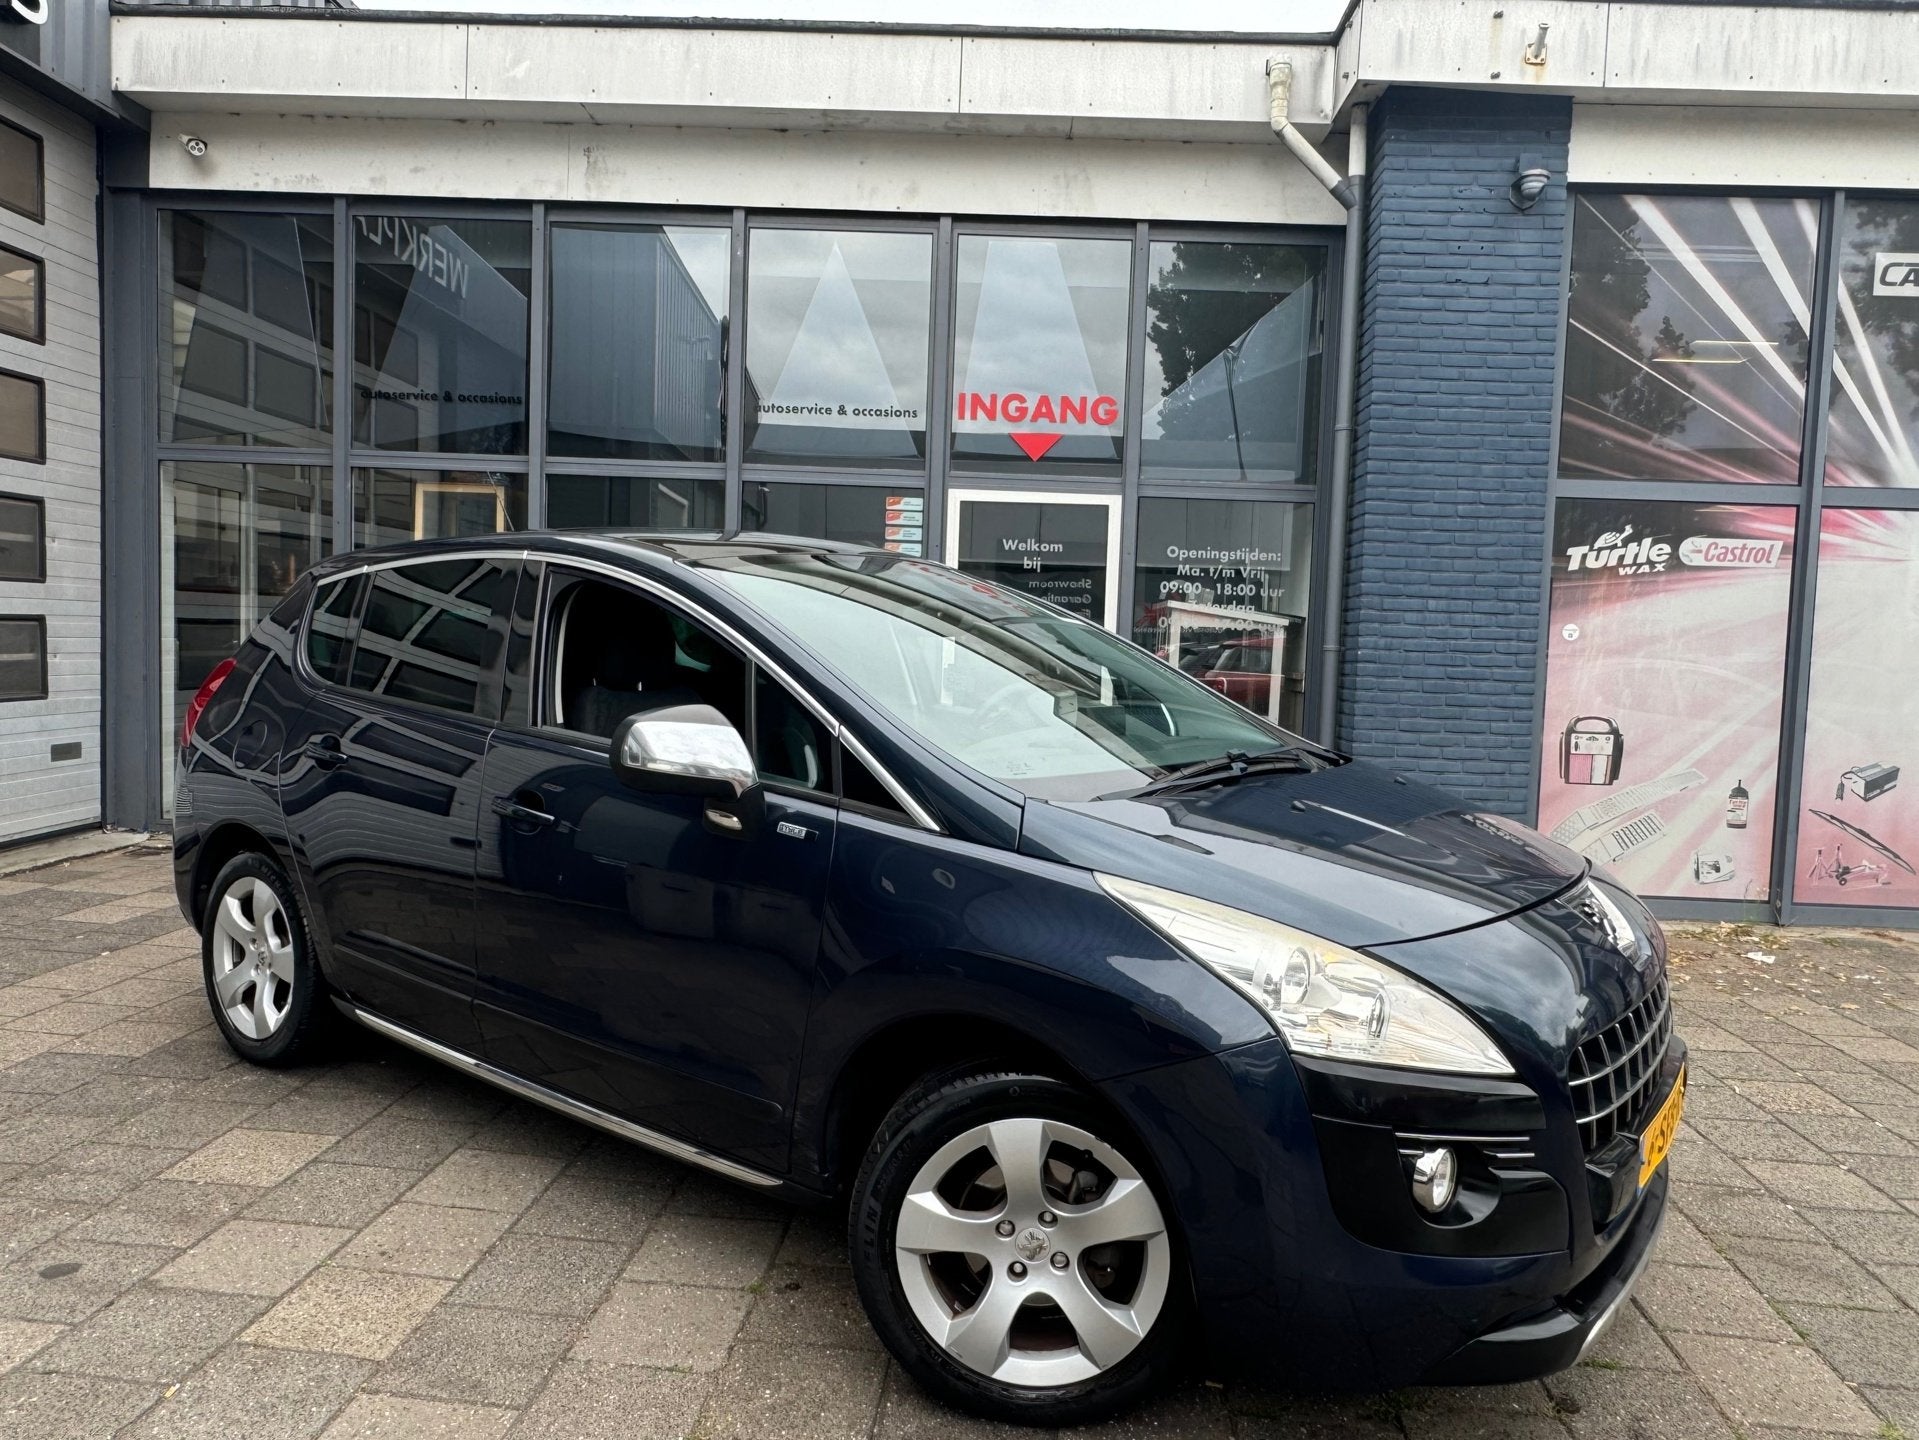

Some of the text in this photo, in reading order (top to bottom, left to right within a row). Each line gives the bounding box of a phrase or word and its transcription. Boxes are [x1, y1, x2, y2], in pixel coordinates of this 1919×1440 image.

[360, 389, 523, 405] autoservice & occasions
[755, 403, 919, 419] autoservice & occasions
[957, 392, 1119, 426] INGANG
[1002, 538, 1064, 552] Welkom
[1166, 545, 1282, 563] Openingstijden:
[1703, 541, 1775, 564] Castrol
[1023, 556, 1041, 573] bij
[1566, 537, 1672, 576] Turtle WAX
[1176, 564, 1265, 583] Ma. t/m Vrij
[1159, 580, 1202, 594] 09:00
[1216, 583, 1256, 596] 18:00
[1260, 587, 1286, 598] uur
